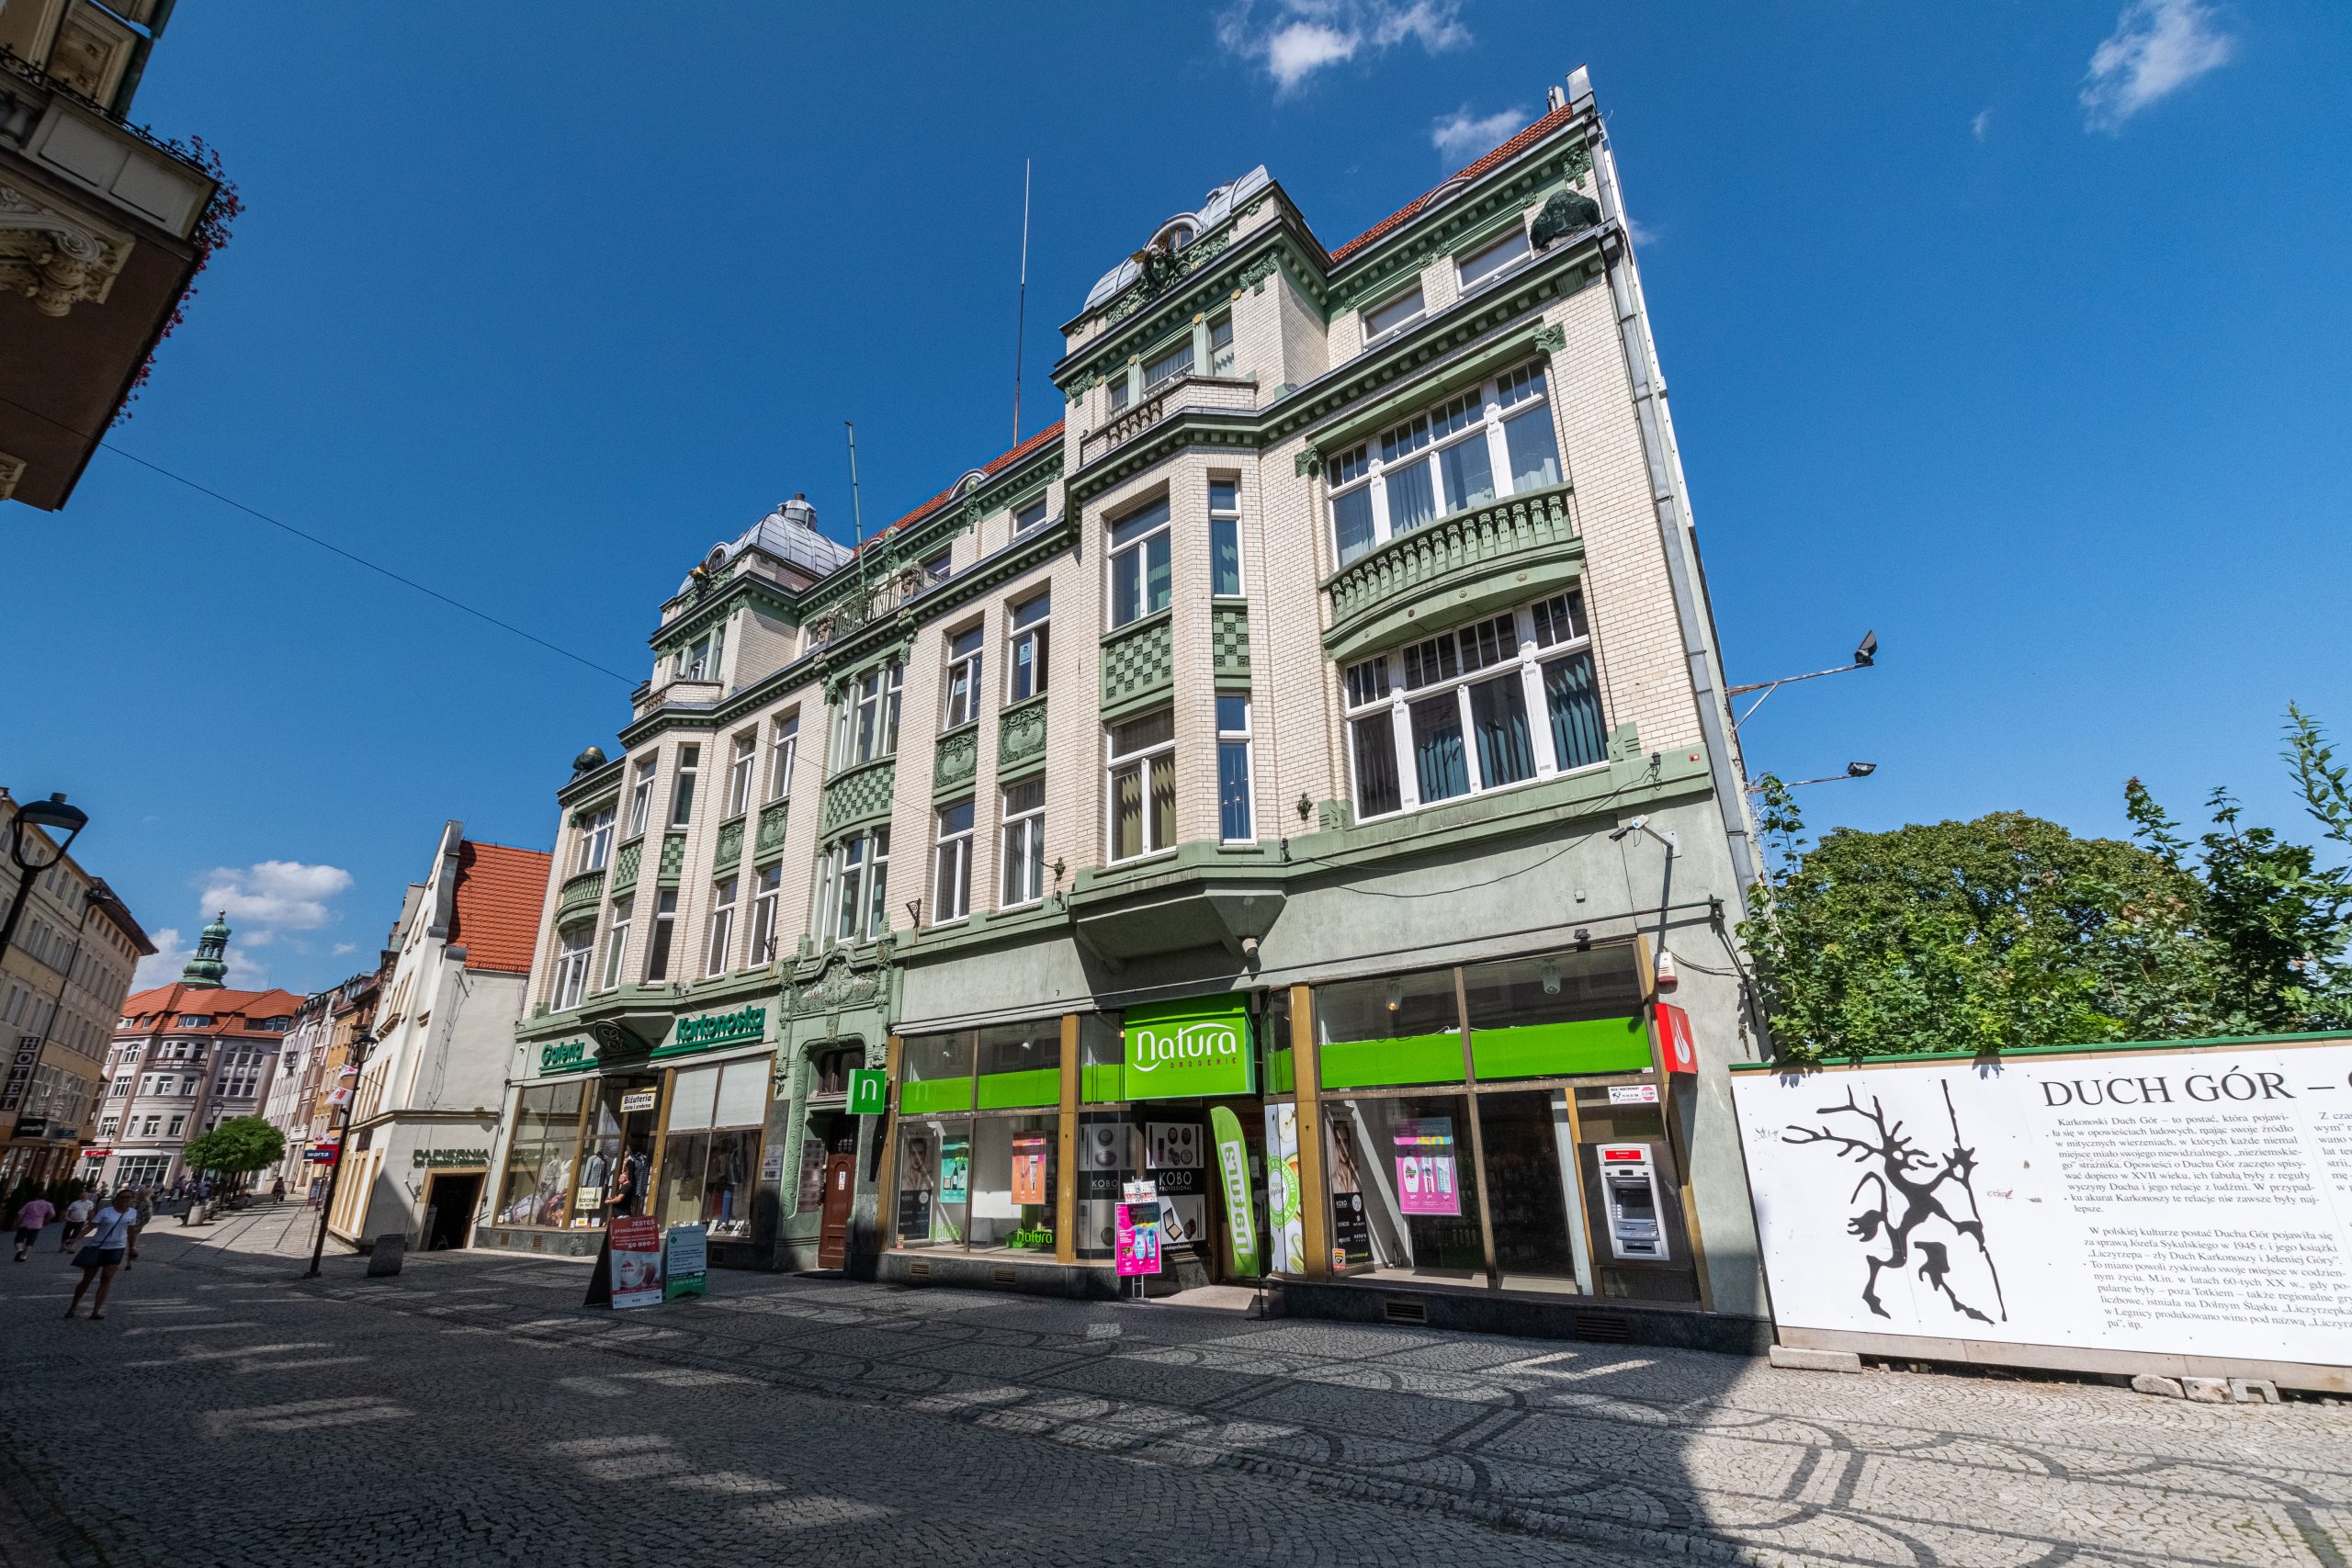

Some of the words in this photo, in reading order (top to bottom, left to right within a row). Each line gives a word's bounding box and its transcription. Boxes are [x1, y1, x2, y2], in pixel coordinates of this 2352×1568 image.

[676, 1005, 766, 1045] Karkonoska
[541, 1039, 586, 1067] Galeria
[1133, 1023, 1237, 1072] Natura
[2, 1037, 38, 1110] HOTEL
[1170, 1057, 1237, 1069] DROGERIE
[862, 1078, 876, 1100] n
[2038, 1077, 2176, 1107] DUCH
[2185, 1065, 2298, 1101] GÓR
[20, 1124, 44, 1133] empik
[413, 1149, 490, 1159] PAPIERNIA
[1091, 1179, 1119, 1188] KOBO
[1159, 1171, 1193, 1186] KOBO
